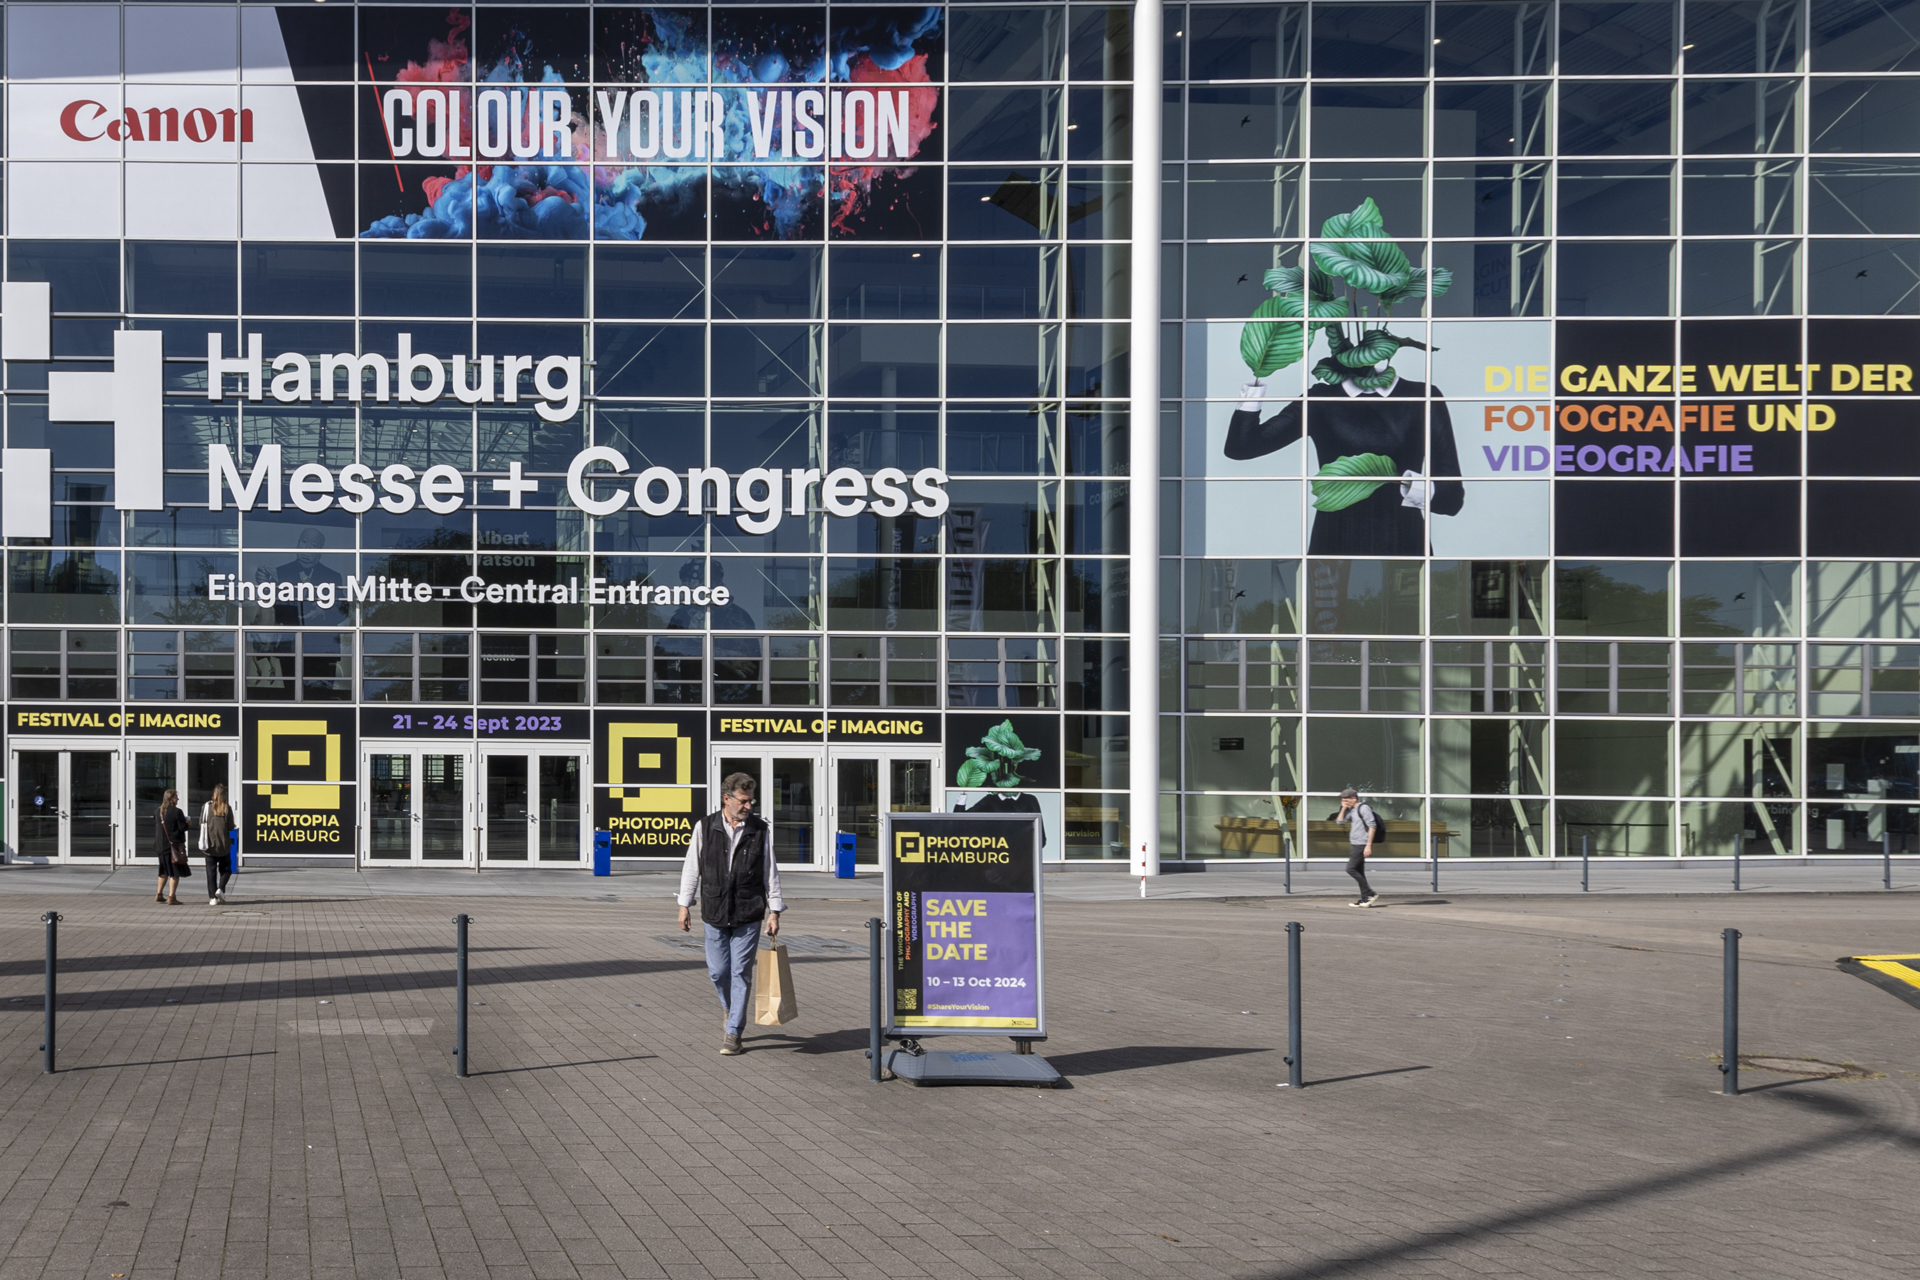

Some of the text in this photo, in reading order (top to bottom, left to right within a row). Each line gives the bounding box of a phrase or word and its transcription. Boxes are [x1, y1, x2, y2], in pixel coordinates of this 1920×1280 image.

[60, 99, 254, 144] Canon
[383, 88, 911, 159] COLOUR YOUR VISION
[207, 332, 582, 424] Hamburg
[1484, 364, 1913, 392] DIE GANZE WELT DER
[1484, 404, 1836, 432] FOTOGRAFIE UND
[1483, 444, 1753, 472] VIDEOGRAFIE
[208, 444, 465, 514] Messe
[567, 446, 949, 535] Congress
[472, 530, 529, 545] Albert
[465, 554, 535, 567] Watson
[208, 574, 335, 609] Eingang
[347, 574, 433, 604] Mitte
[460, 576, 577, 605] Central
[590, 578, 730, 607] Entrance
[17, 712, 221, 728] FESTIVAL OF IMAGING
[392, 715, 411, 729] 21
[433, 715, 458, 730] 24
[463, 715, 509, 733] Sept
[515, 716, 562, 731] 2023
[720, 718, 923, 735] FESTIVAL OF IMAGING
[256, 814, 340, 826] PHOTOPIA
[609, 817, 692, 830] PHOTOPIA
[256, 829, 340, 842] HAMBURG
[609, 833, 692, 846] HAMBURG
[927, 836, 1009, 849] PHOTOPIA
[927, 851, 1010, 864] HAMBURG
[896, 891, 903, 901] OF
[926, 899, 987, 917] SAVE
[926, 921, 972, 938] THE
[926, 943, 987, 960] DATE
[927, 976, 941, 987] 10
[953, 976, 965, 988] 13
[968, 976, 991, 988] Oct
[994, 976, 1027, 988] 2024
[927, 1002, 990, 1011] #ShareYourVision
